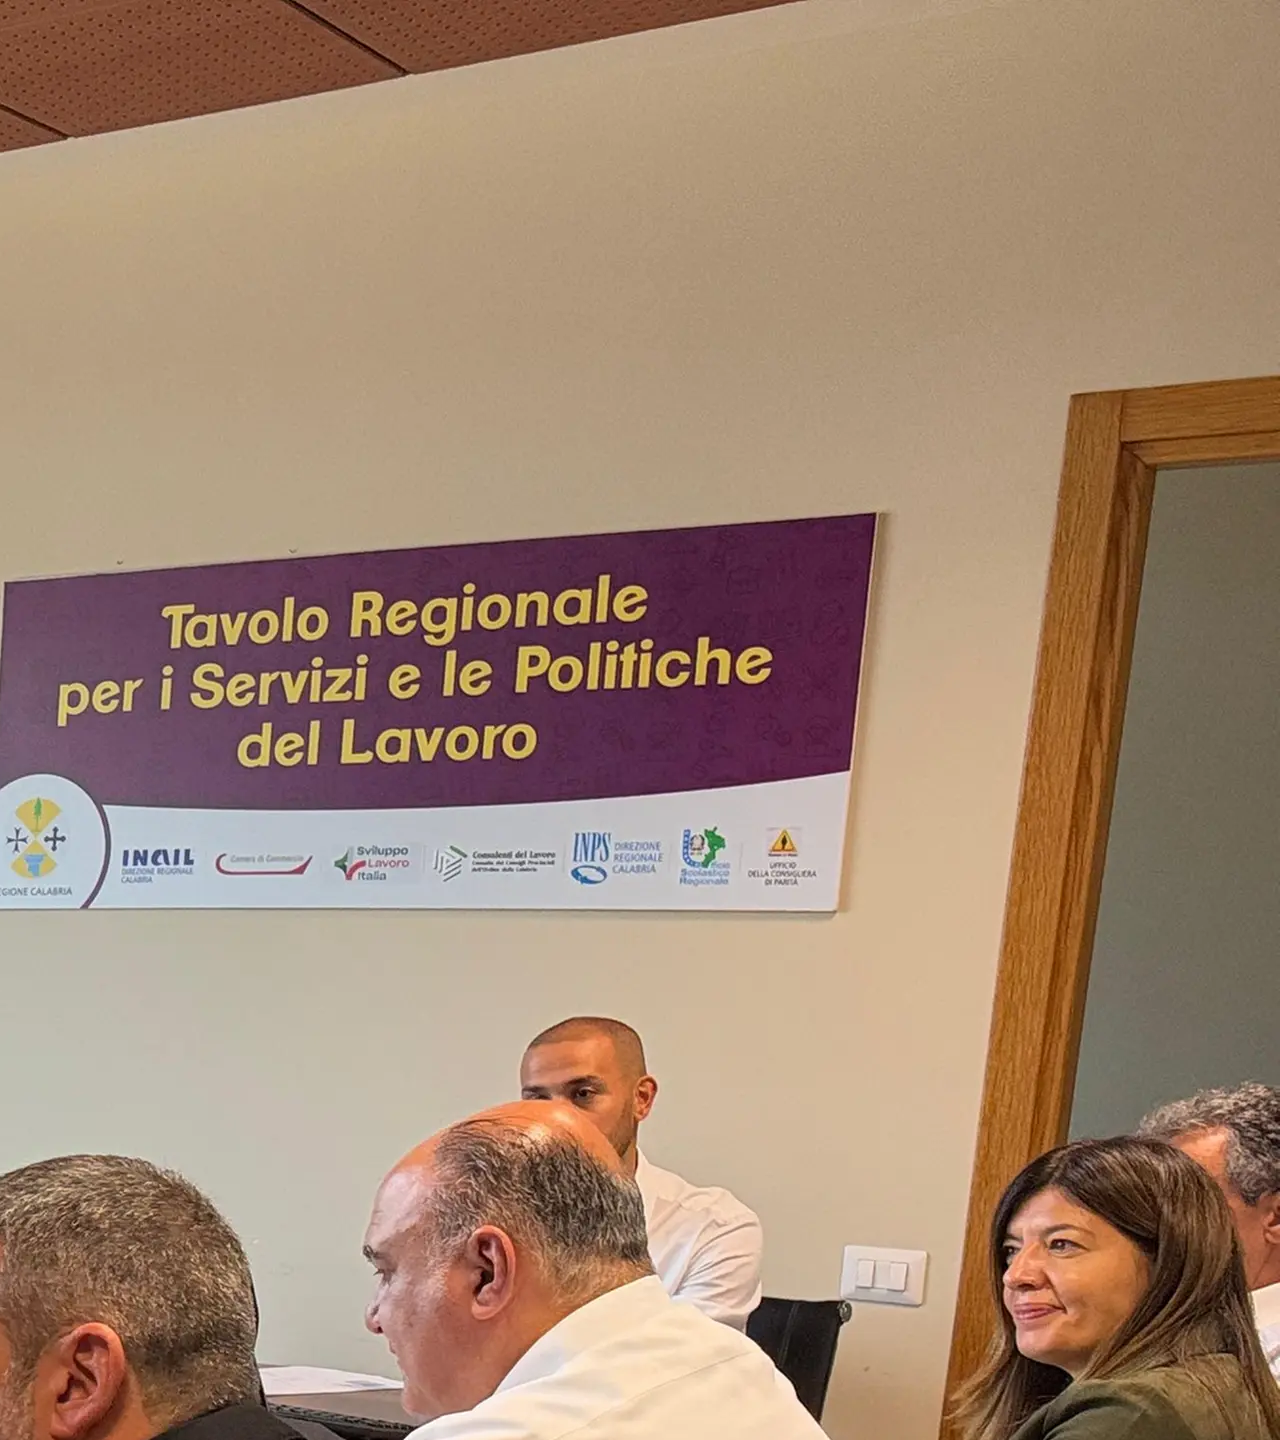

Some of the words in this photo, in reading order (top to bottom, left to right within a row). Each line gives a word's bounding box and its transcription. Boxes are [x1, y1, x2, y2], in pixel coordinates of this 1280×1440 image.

[160, 596, 329, 649] Tavolo
[350, 574, 648, 646] Regionale
[57, 679, 143, 727] per
[160, 665, 174, 710] i
[190, 654, 369, 709] Servizi
[388, 664, 421, 700] e
[442, 649, 493, 697] le
[515, 636, 773, 693] Politiche
[237, 719, 321, 768] del
[340, 718, 537, 765] Lavoro
[357, 845, 409, 857] Sviluppo
[572, 832, 612, 863] INPS
[614, 842, 661, 851] DIREZIONE
[122, 848, 195, 867] INAIL
[515, 850, 527, 859] del
[529, 850, 556, 859] Lavoro
[613, 853, 664, 863] REGIONALE
[368, 857, 410, 868] Lavoro
[612, 864, 657, 874] CALABRIA
[680, 868, 730, 877] Scolastico
[747, 870, 769, 878] DELLA
[121, 876, 153, 884] CALABRIA
[357, 871, 387, 881] Italia
[679, 877, 729, 887] Regionale
[30, 887, 73, 896] CALABRIA
